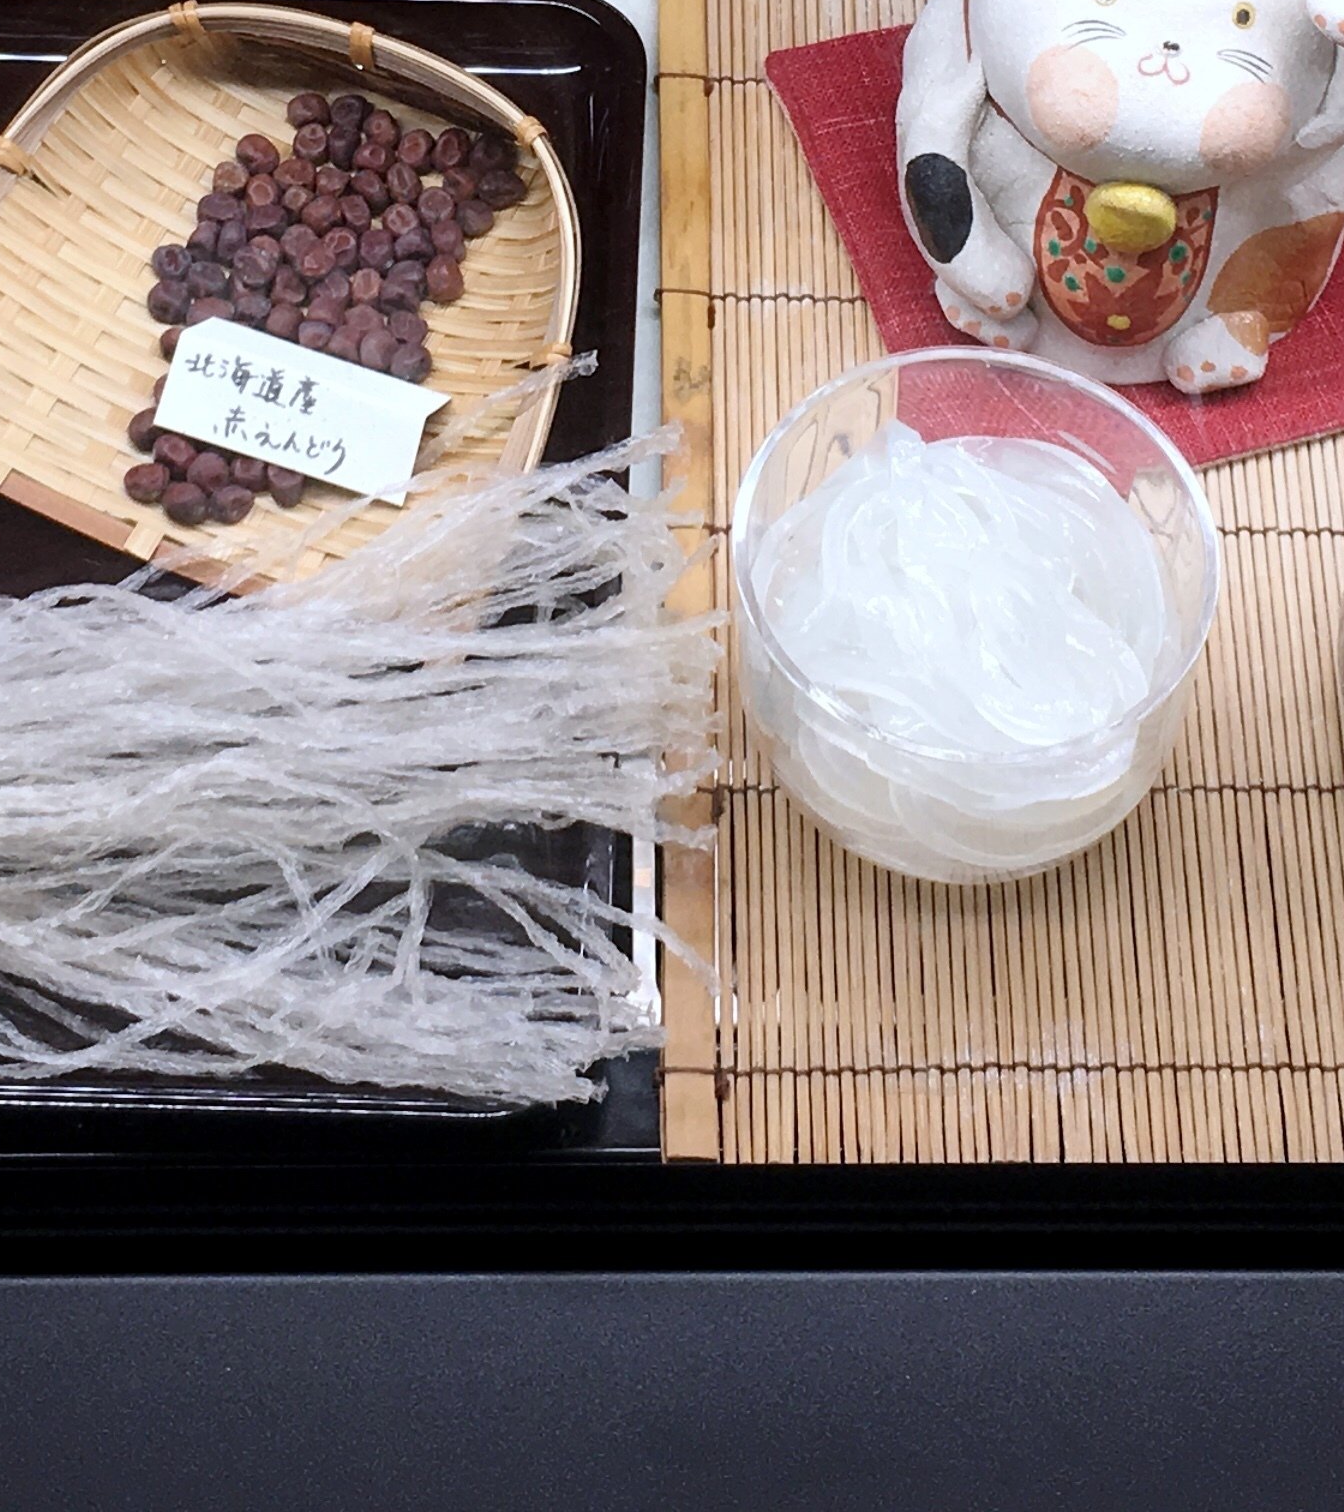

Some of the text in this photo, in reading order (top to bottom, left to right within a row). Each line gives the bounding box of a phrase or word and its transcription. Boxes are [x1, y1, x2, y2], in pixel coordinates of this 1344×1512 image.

[185, 353, 321, 416] 北海道産
[213, 406, 346, 475] 赤えんどう
